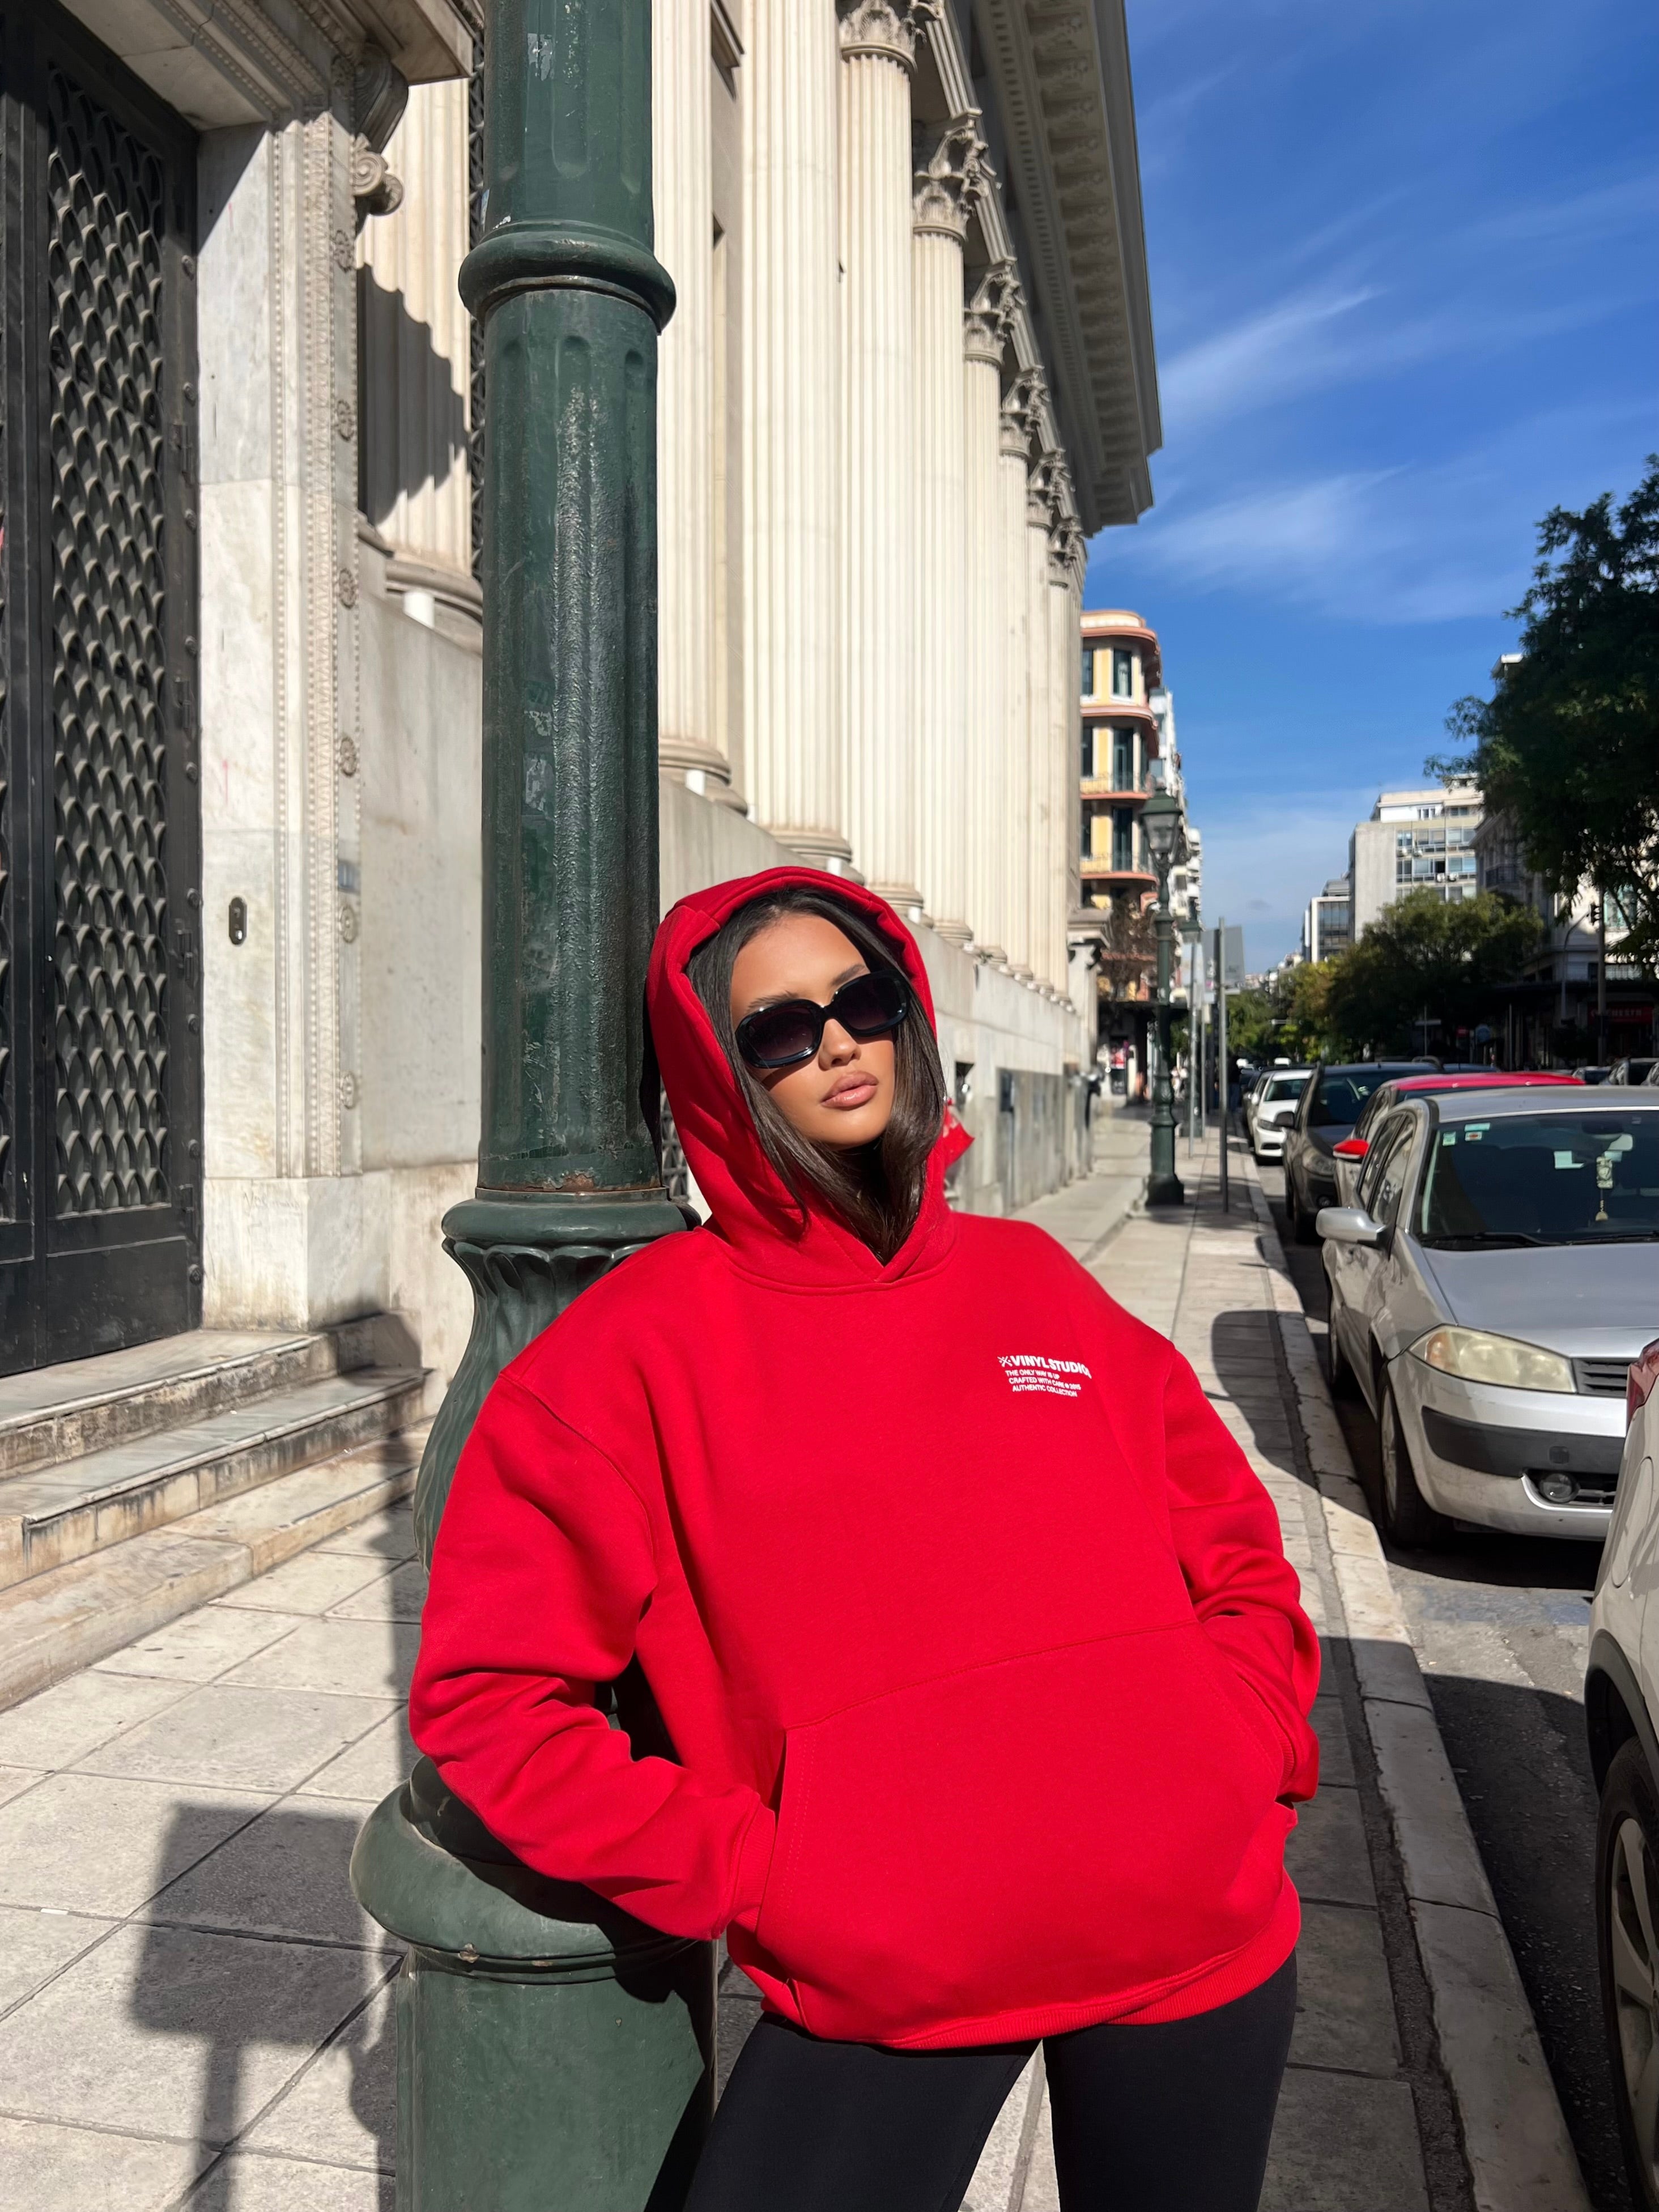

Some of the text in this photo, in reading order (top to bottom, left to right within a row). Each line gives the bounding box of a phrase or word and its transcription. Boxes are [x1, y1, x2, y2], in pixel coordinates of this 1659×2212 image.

[1010, 1355, 1049, 1368] VINYL
[1052, 1380, 1065, 1388] CARE
[1046, 1385, 1078, 1397] COLLECTION
